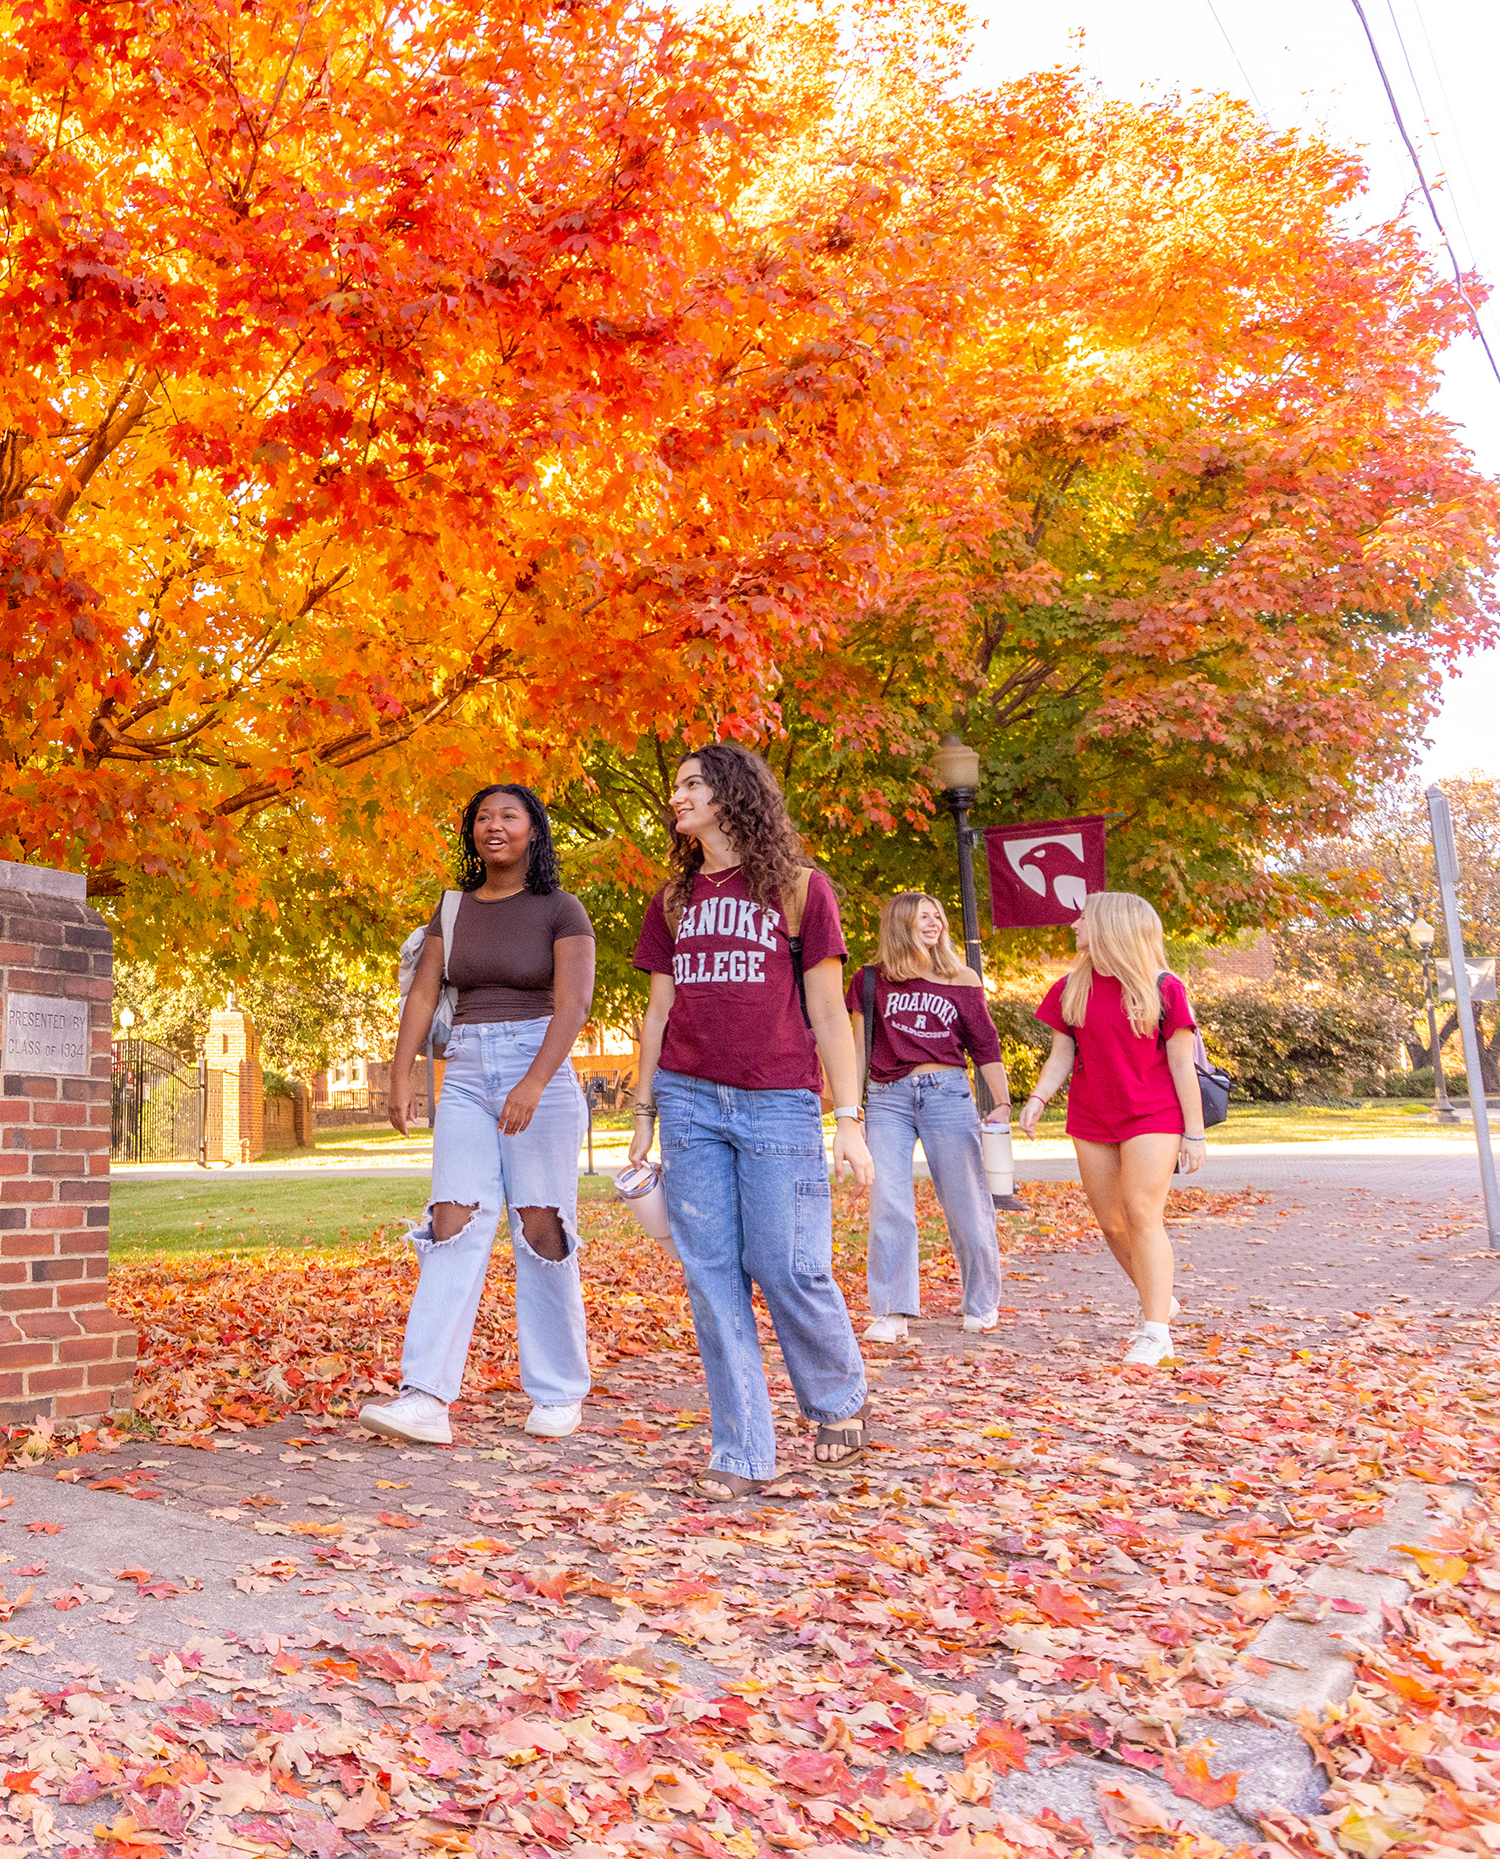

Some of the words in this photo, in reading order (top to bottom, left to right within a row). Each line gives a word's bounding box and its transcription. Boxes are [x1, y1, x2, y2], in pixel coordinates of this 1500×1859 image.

[675, 896, 781, 951] ANOKE
[672, 950, 766, 985] OLLEGE
[9, 1010, 66, 1030] PRESENTED
[73, 1016, 86, 1032] BY
[884, 992, 958, 1029] ROANOKE
[914, 1014, 927, 1030] R
[8, 1038, 41, 1056] CLASS
[45, 1045, 56, 1056] OF
[61, 1043, 84, 1058] 1934
